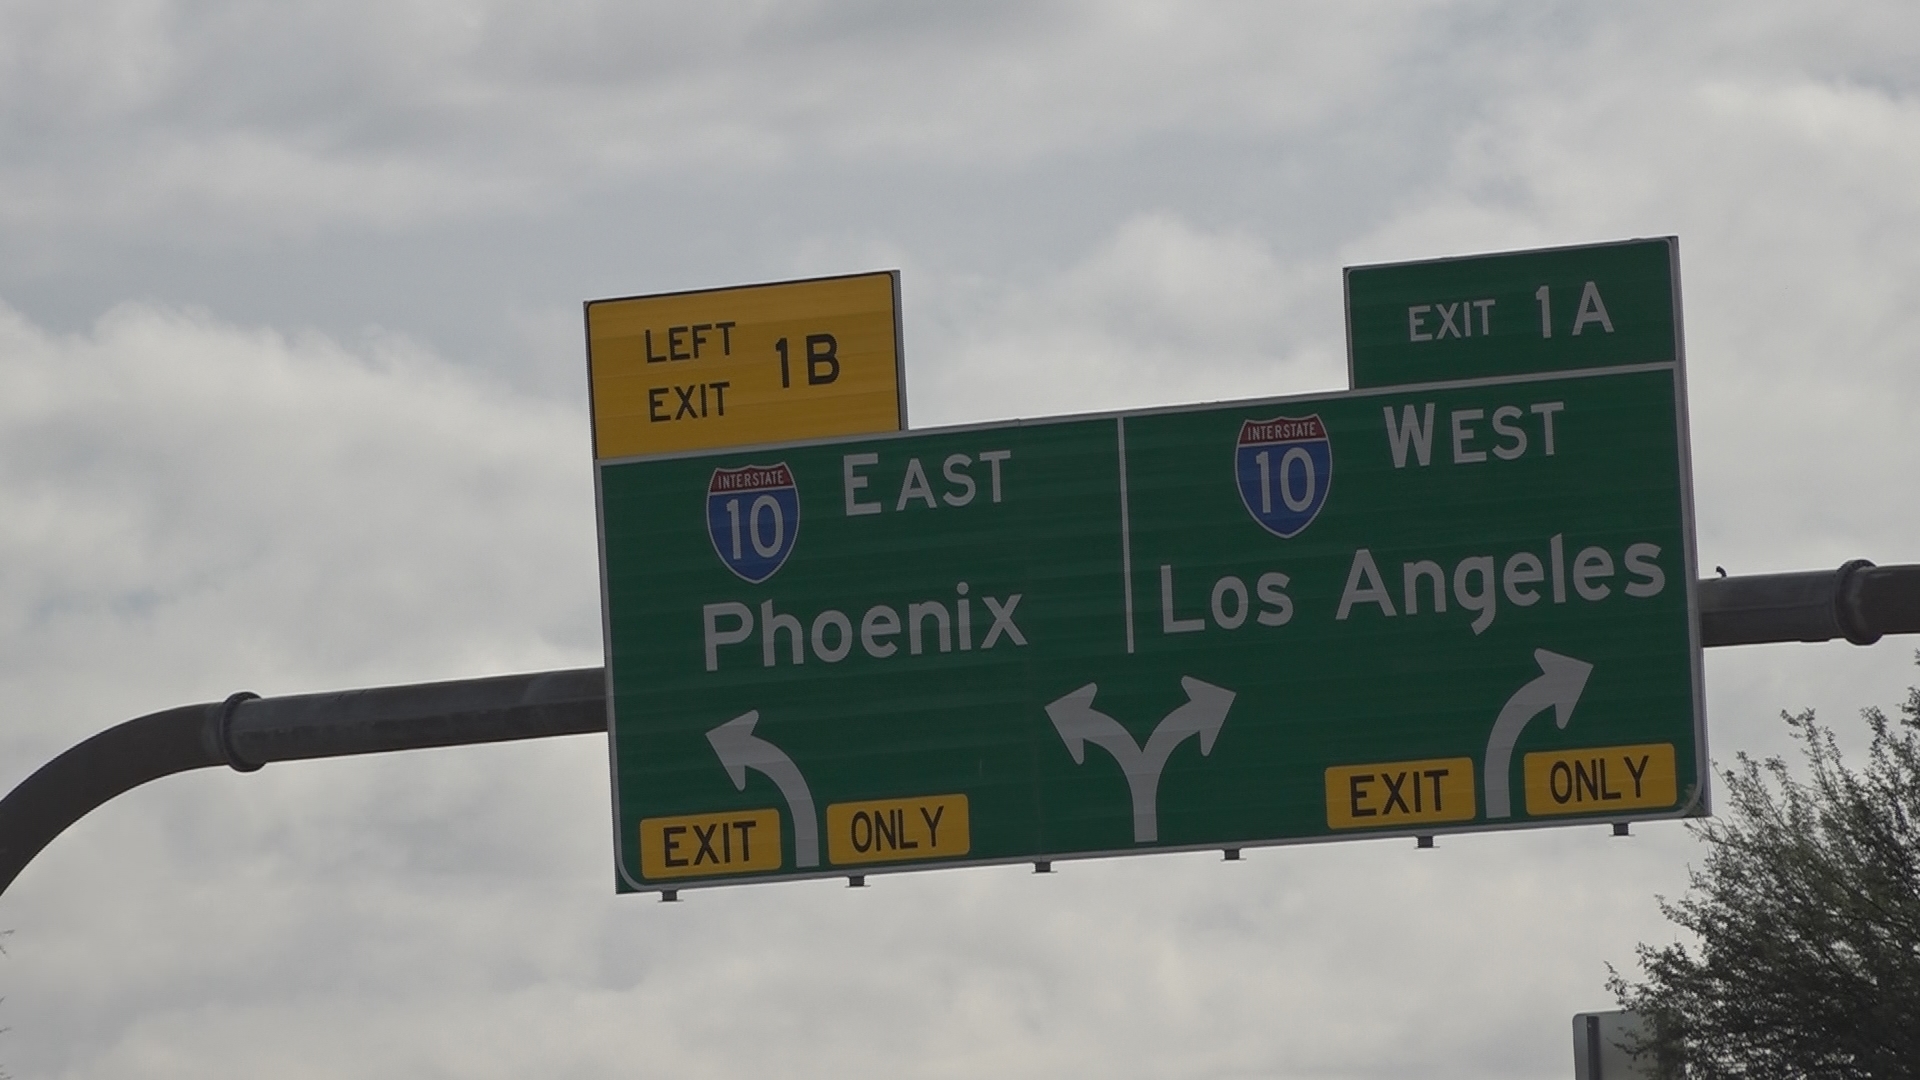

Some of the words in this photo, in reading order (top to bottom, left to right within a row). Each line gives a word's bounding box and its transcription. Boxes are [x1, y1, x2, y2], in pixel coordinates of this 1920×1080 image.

[644, 321, 736, 364] LEFT
[1408, 299, 1496, 342] EXIT
[1535, 281, 1615, 338] 1A
[775, 333, 841, 389] 1B
[648, 381, 731, 423] EXIT
[1246, 420, 1318, 441] INTERSTATE
[1383, 401, 1565, 468] WEST
[716, 468, 786, 490] INTERSTATE
[842, 449, 1012, 516] EAST
[1254, 446, 1317, 514] 10
[725, 494, 785, 561] 10
[1160, 564, 1295, 634] Los
[1335, 532, 1667, 637] Angeles
[702, 581, 1029, 672] Phoenix
[1349, 768, 1449, 818] EXIT
[1549, 754, 1651, 806] ONLY
[662, 820, 757, 868] EXIT
[850, 805, 945, 854] ONLY
